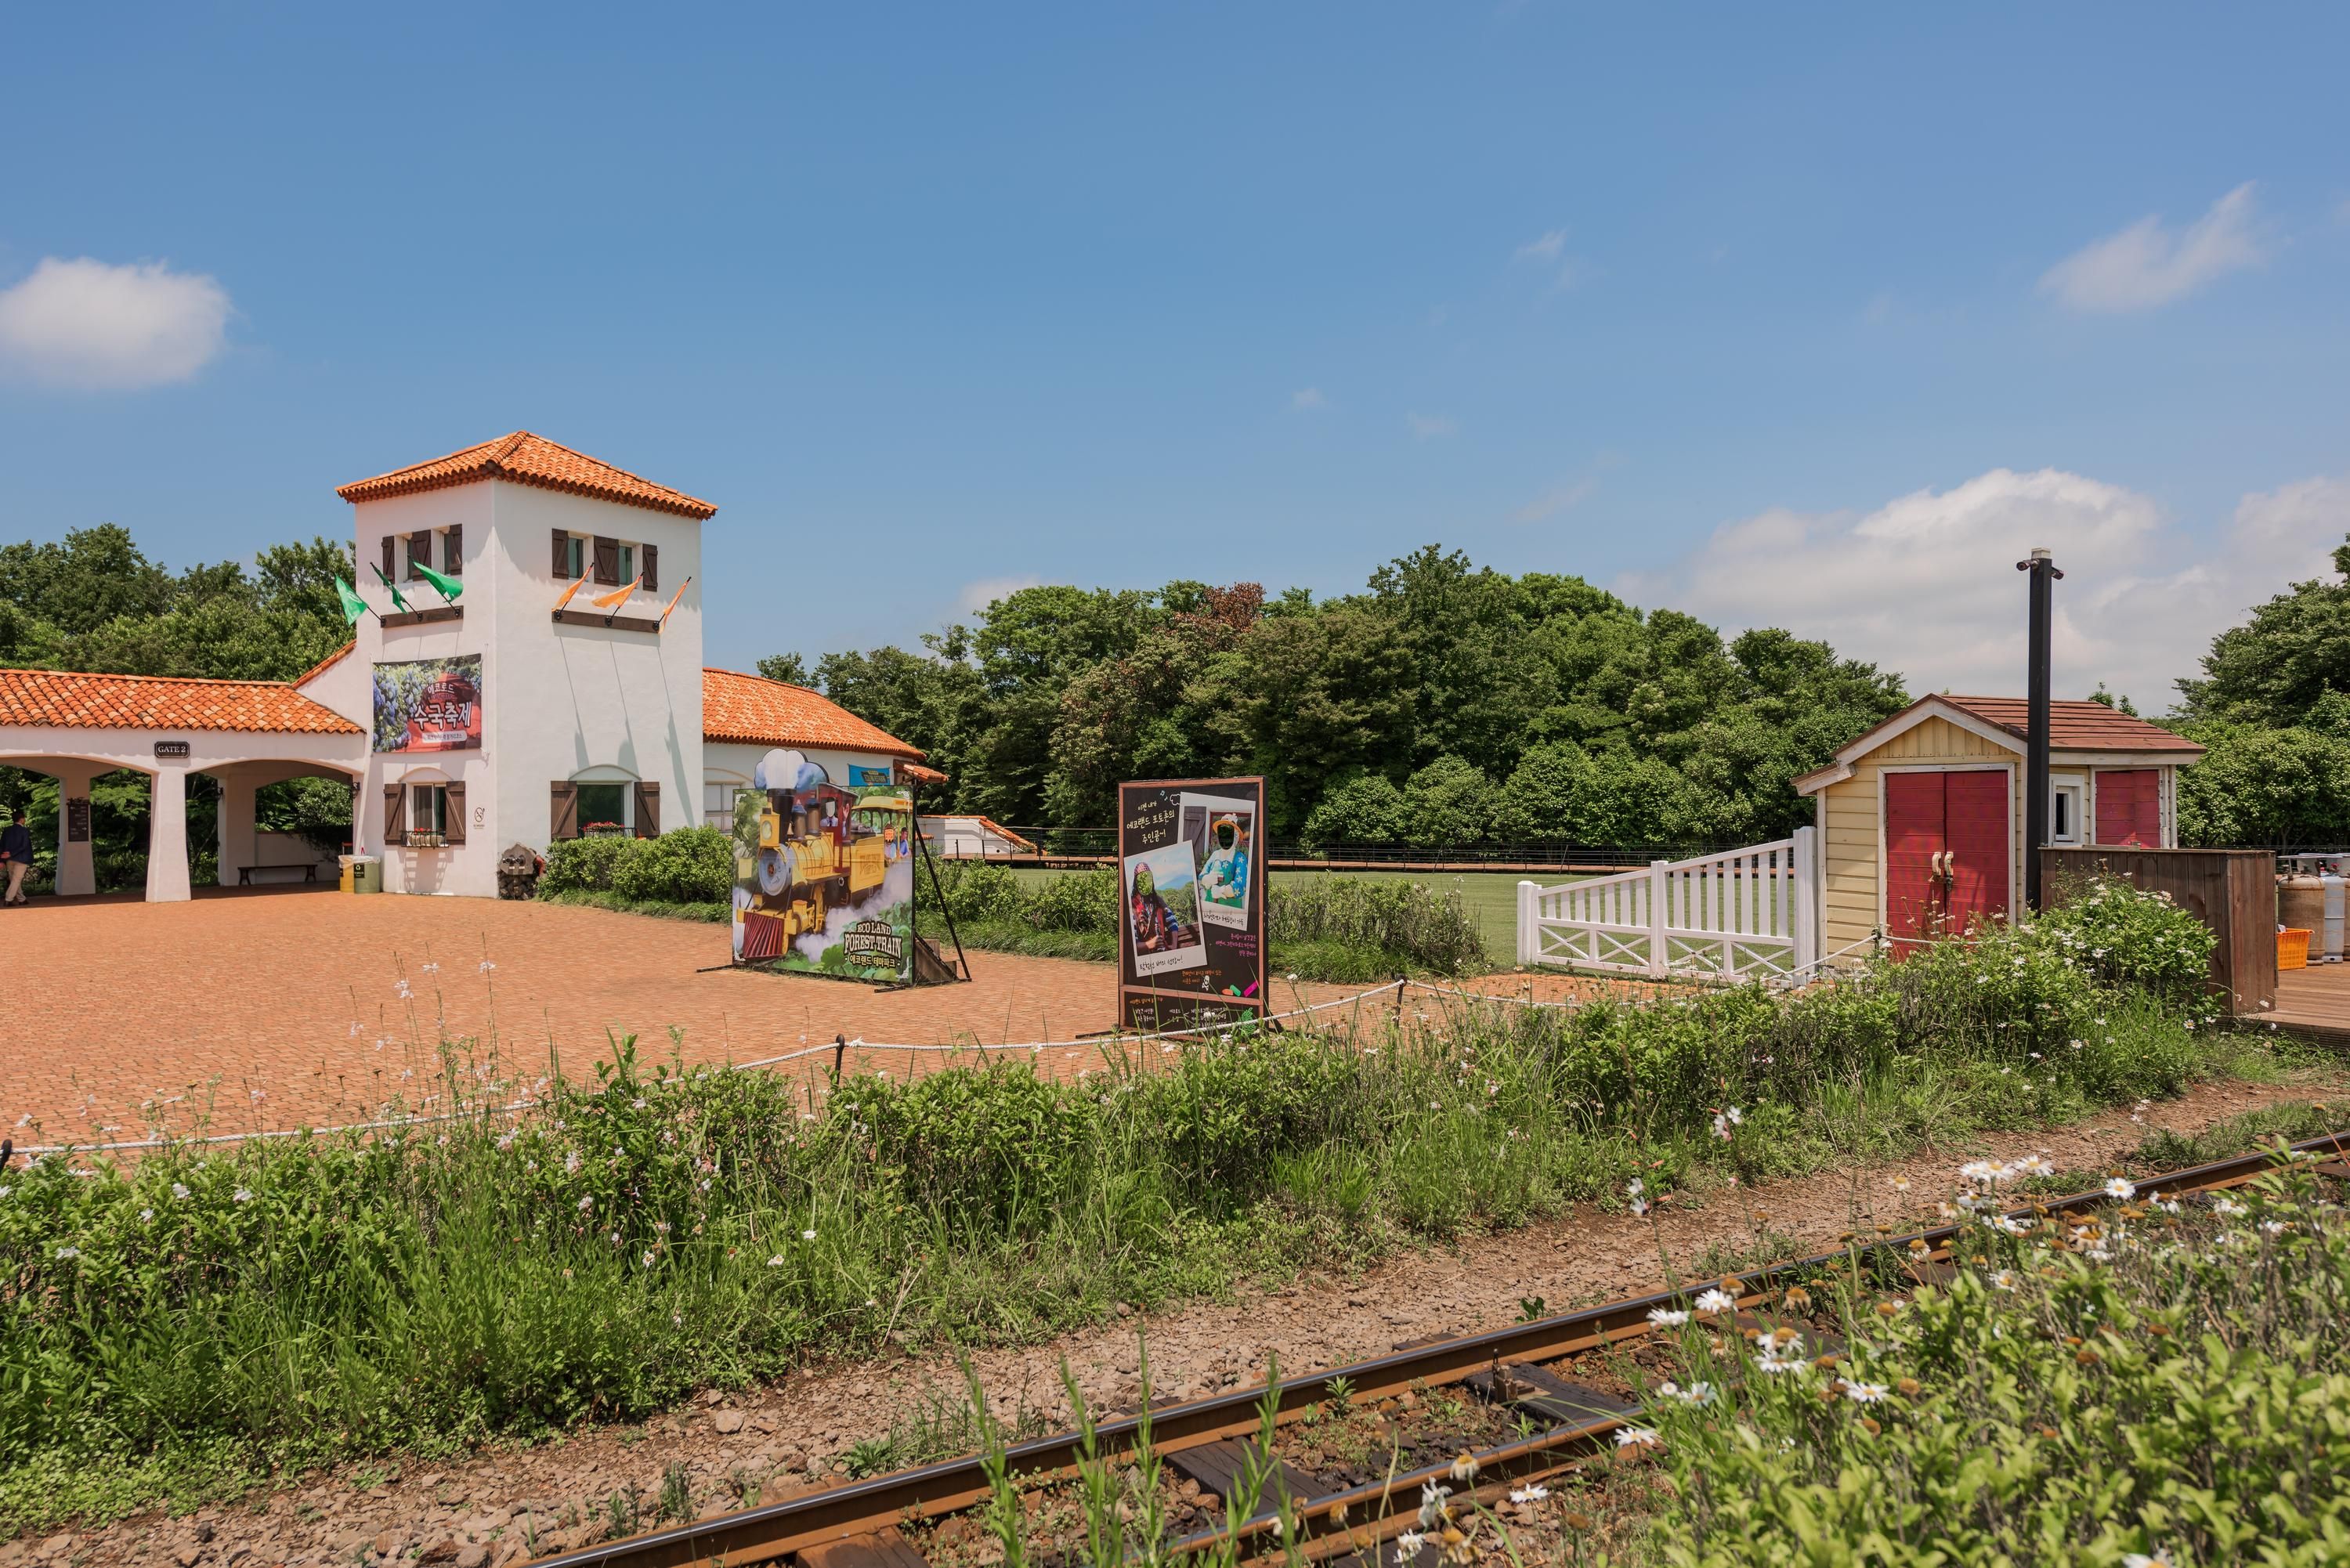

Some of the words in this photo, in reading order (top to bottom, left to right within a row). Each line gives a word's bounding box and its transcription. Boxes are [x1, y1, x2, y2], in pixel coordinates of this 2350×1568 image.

[427, 682, 455, 694] 에코로드
[414, 701, 472, 730] 수국축제
[1126, 816, 1151, 829] 에코랜드
[1152, 809, 1175, 824] 포토존의
[857, 923, 870, 933] ECO
[871, 922, 891, 935] LAND
[844, 933, 876, 954] FOREST
[876, 935, 902, 959] TRAIN
[849, 955, 873, 966] 에코랜드
[873, 957, 896, 968] 테마파크
